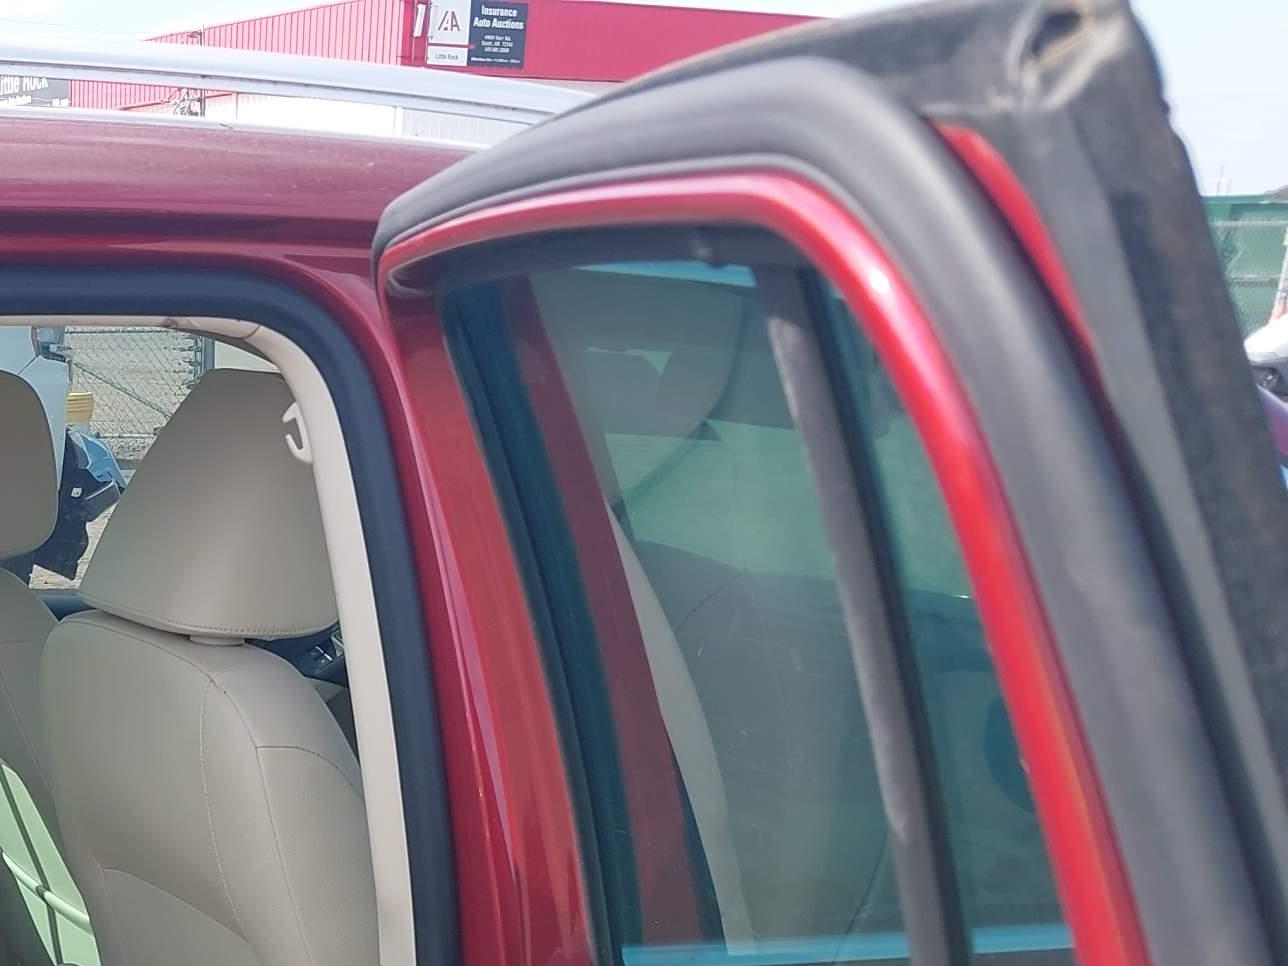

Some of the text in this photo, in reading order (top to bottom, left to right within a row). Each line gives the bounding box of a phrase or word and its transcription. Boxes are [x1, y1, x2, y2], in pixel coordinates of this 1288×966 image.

[481, 5, 518, 17] Insurance
[473, 16, 524, 30] Auto Auctions
